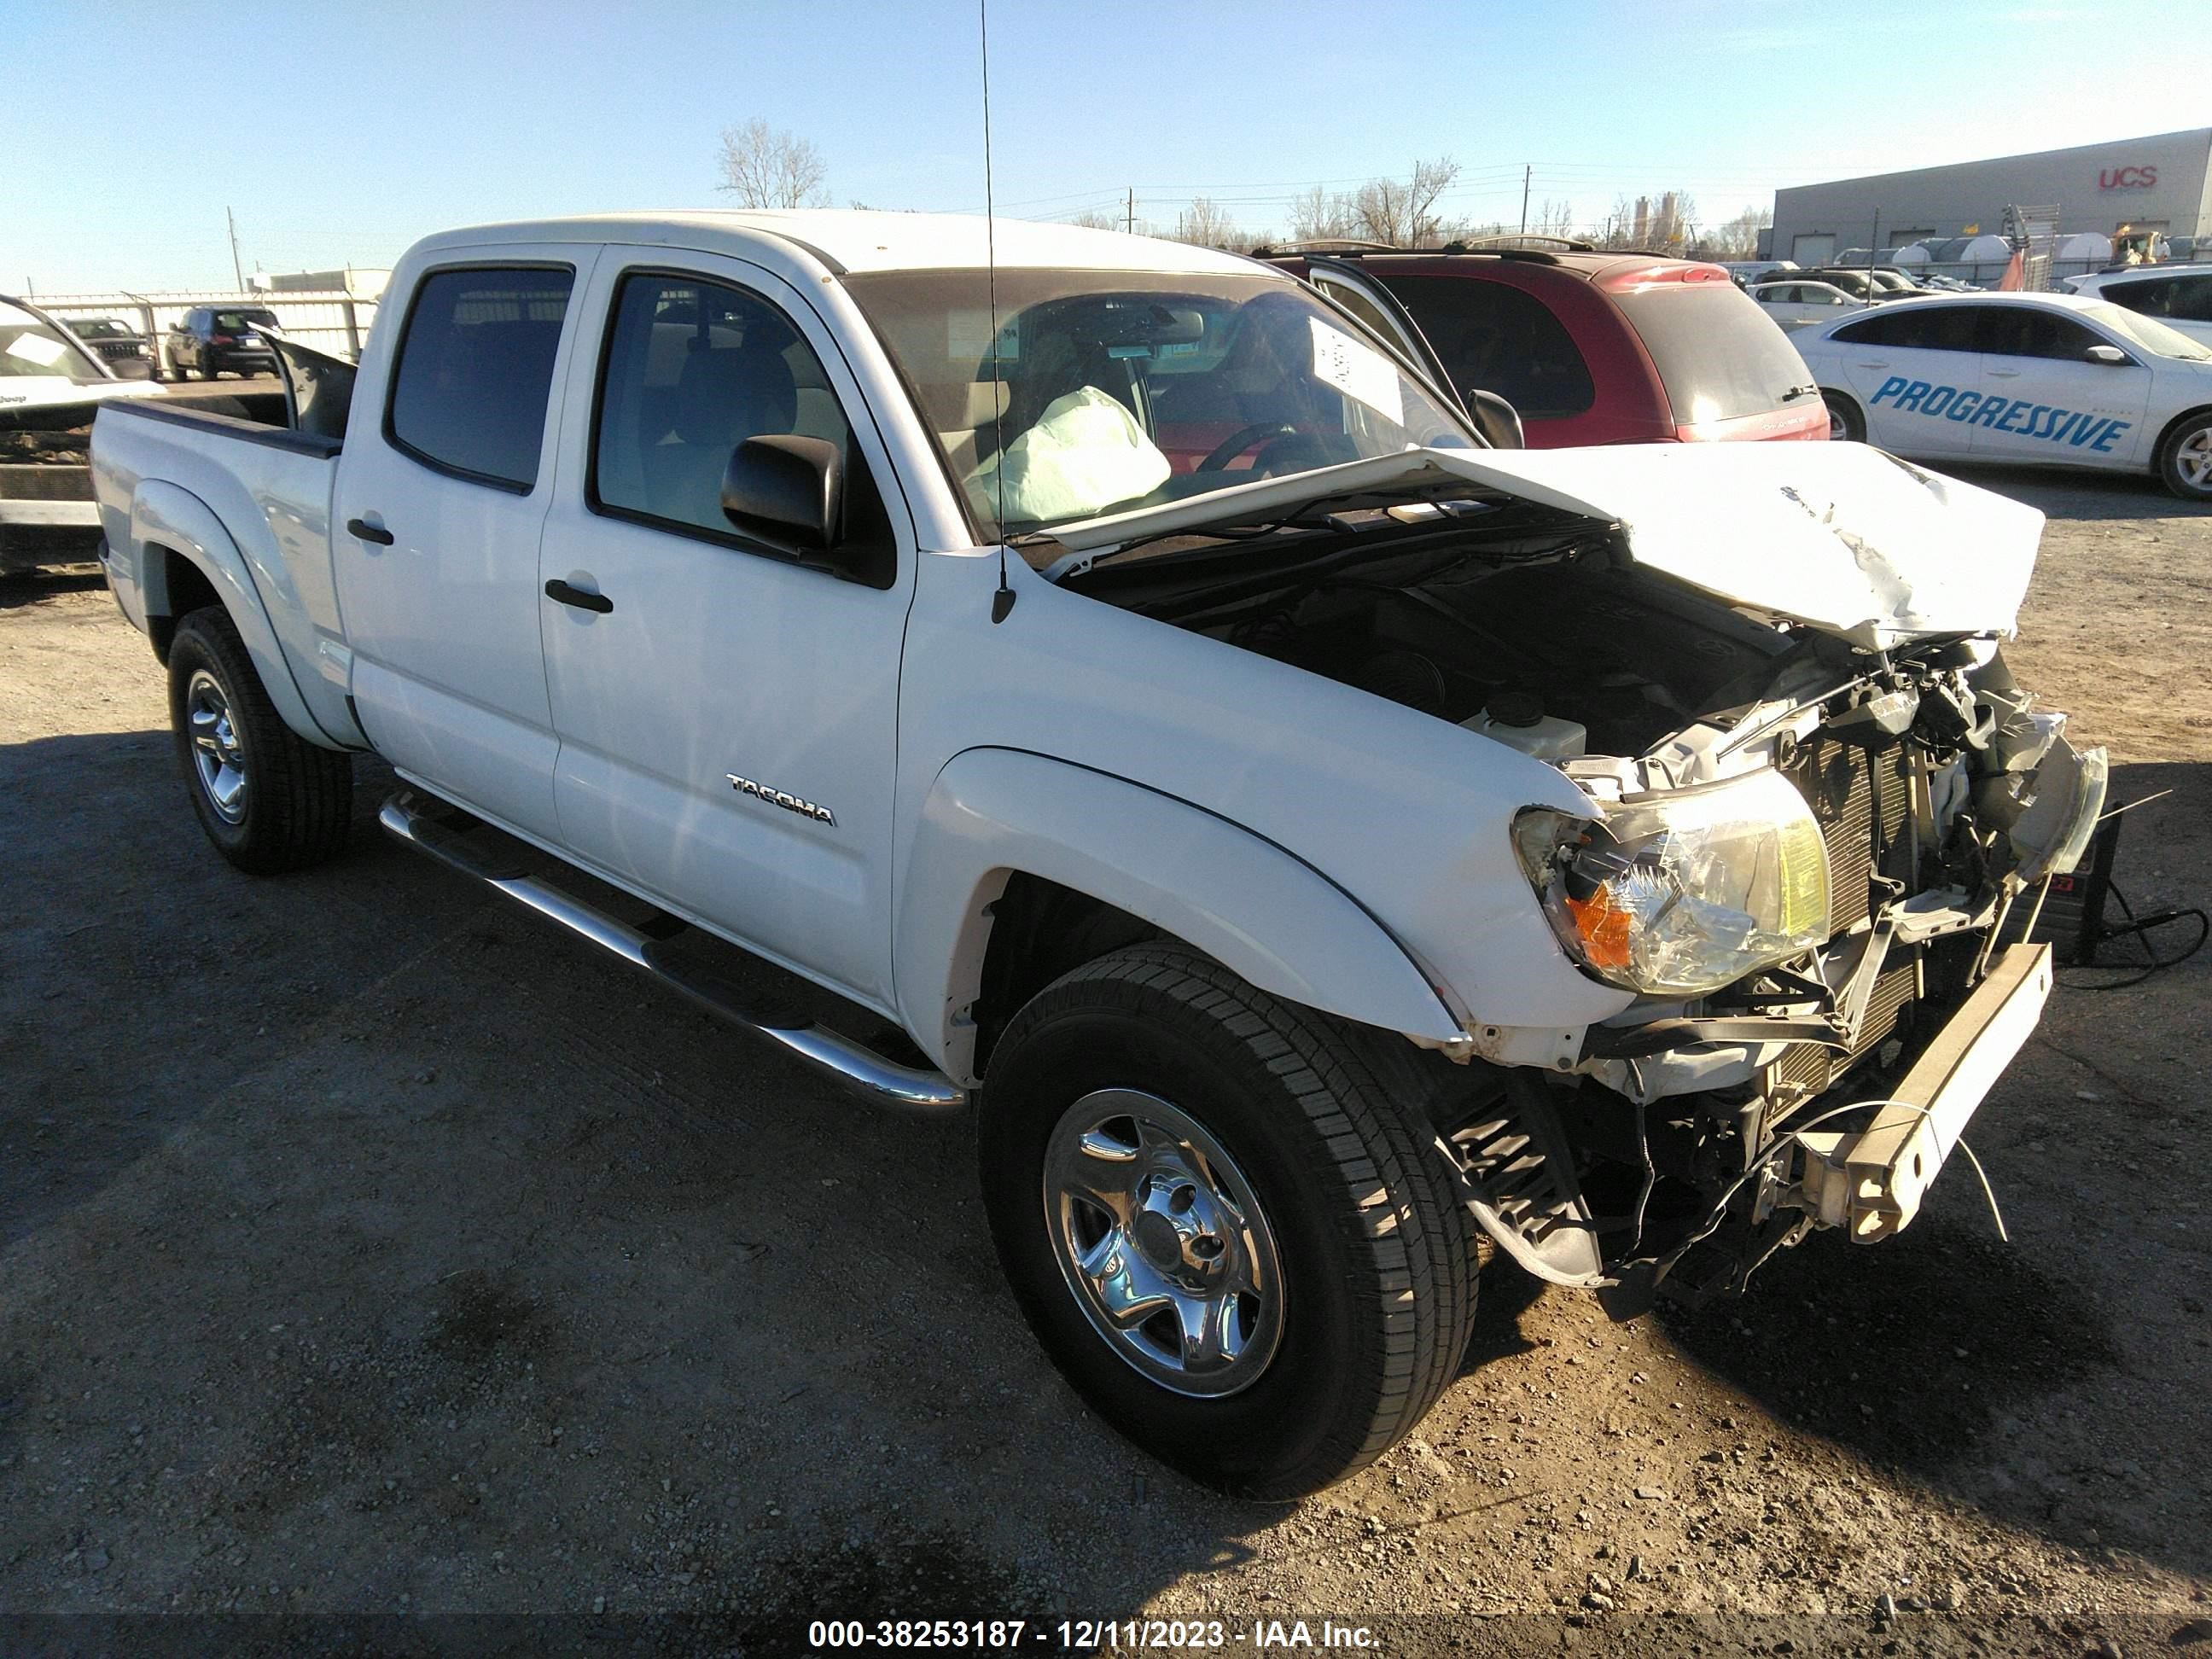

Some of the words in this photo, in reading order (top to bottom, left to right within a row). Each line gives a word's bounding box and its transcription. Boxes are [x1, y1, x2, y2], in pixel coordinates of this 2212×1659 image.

[2099, 166, 2157, 189] UCS
[1870, 376, 2132, 452] PROGRESSIVE
[725, 772, 838, 827] TACOMA
